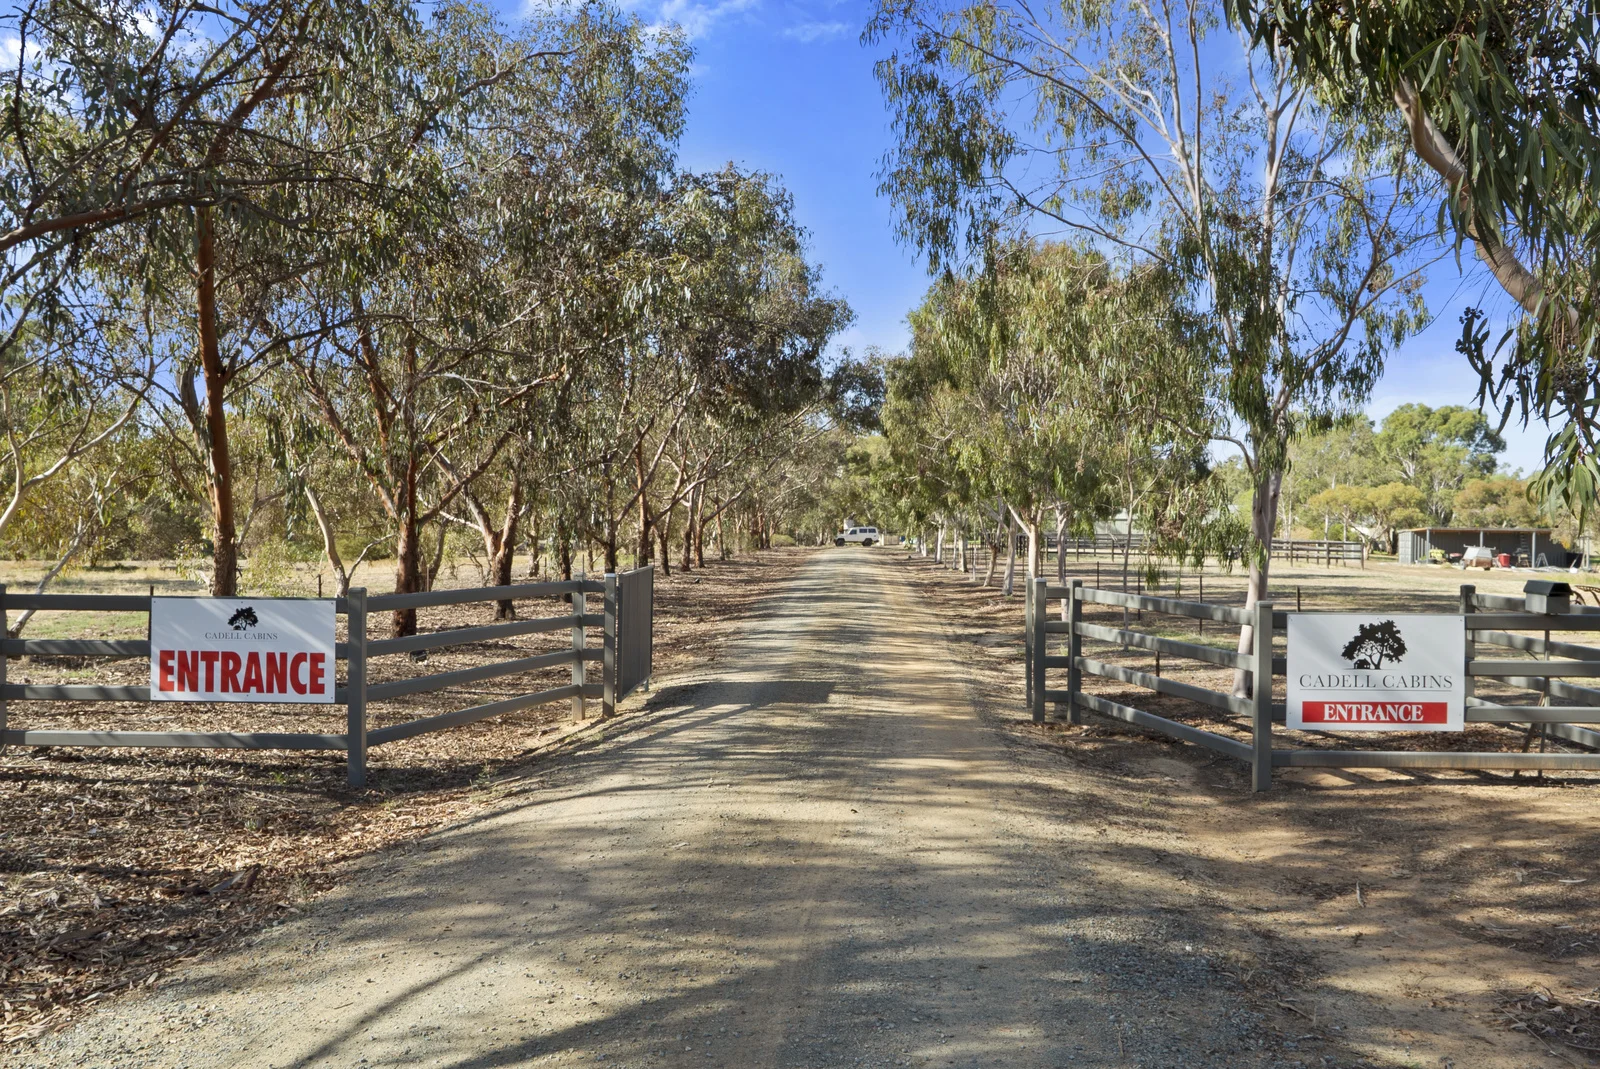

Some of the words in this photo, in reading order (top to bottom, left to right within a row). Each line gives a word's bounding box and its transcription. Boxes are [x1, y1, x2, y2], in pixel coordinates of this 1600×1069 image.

[204, 632, 242, 640] CADELL
[244, 632, 278, 640] CABINS
[159, 650, 326, 695] ENTRANCE
[1299, 674, 1376, 688] CADELL
[1382, 674, 1453, 689] CABINS
[1323, 703, 1424, 722] ENTRANCE
